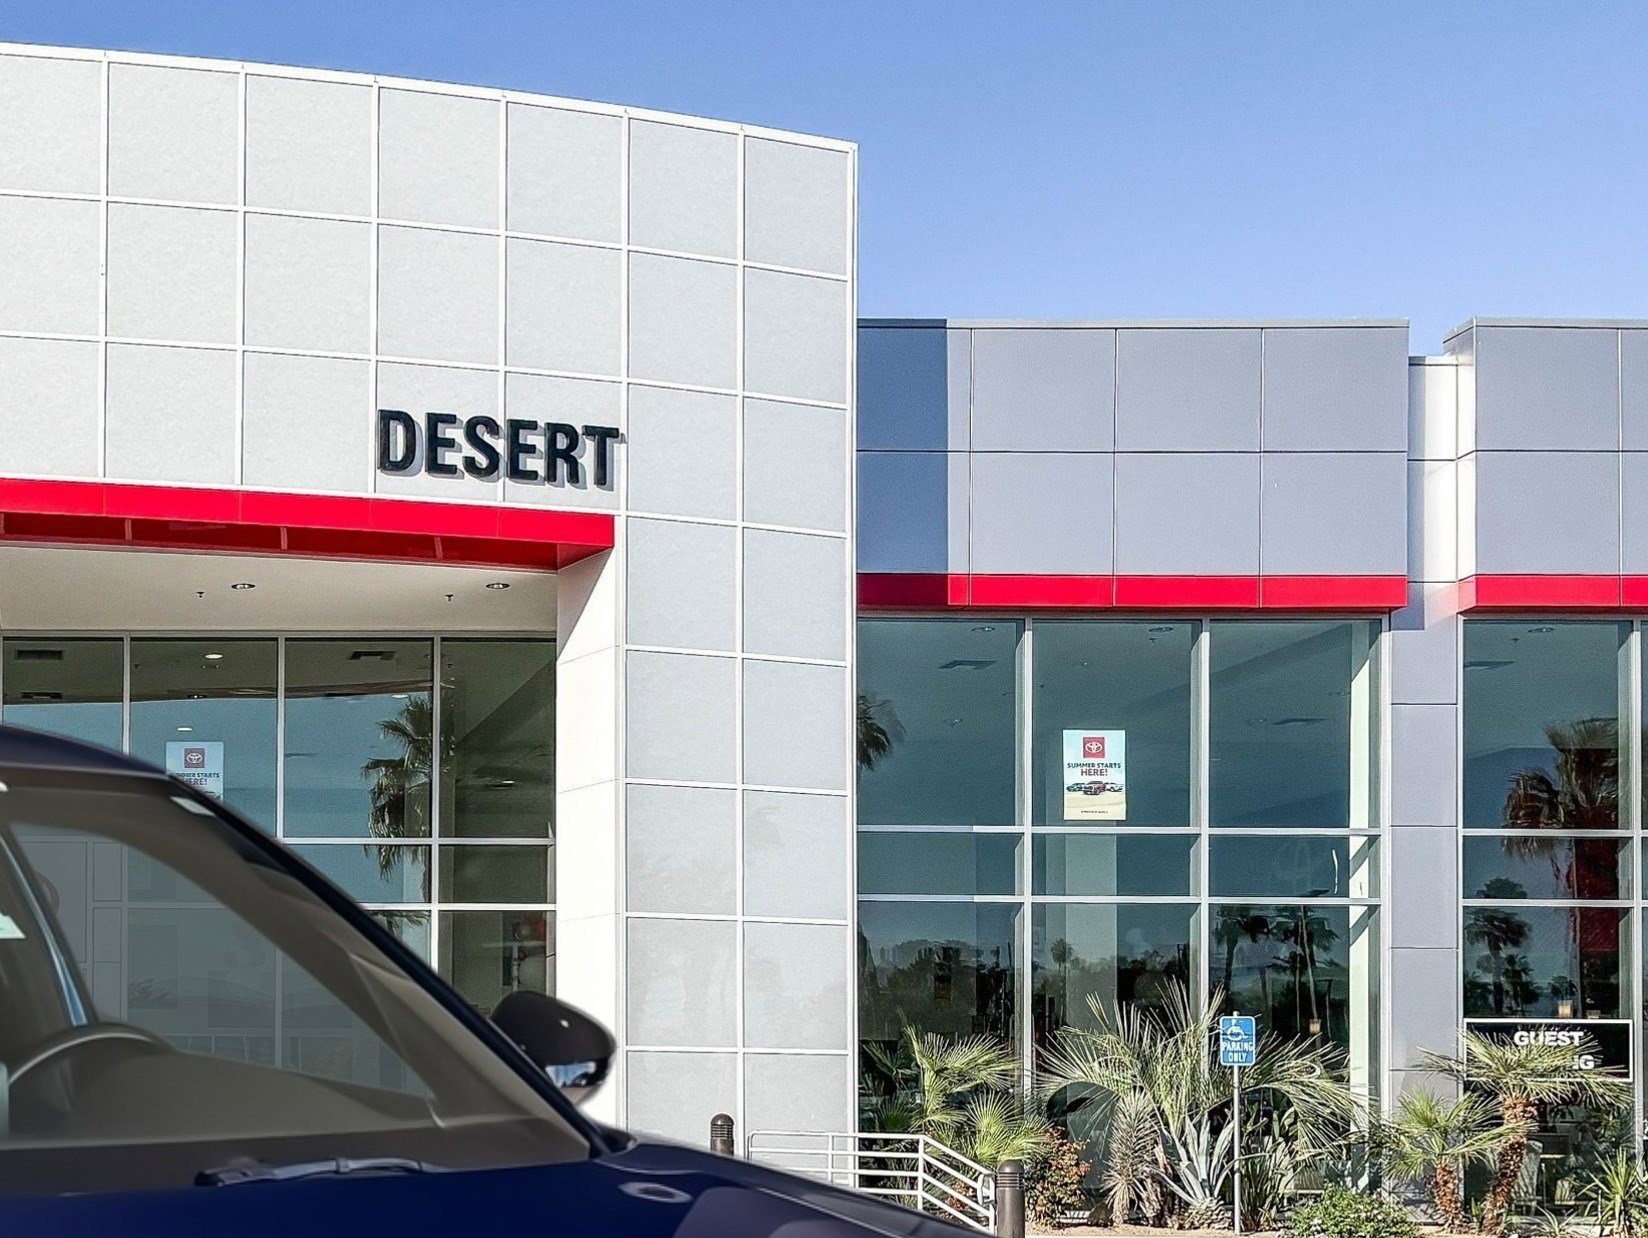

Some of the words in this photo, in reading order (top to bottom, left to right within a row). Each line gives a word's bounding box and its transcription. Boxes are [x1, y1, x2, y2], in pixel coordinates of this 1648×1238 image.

[377, 409, 619, 487] DESERT
[1080, 768, 1108, 776] HERE!
[1513, 1031, 1584, 1047] GUEST
[1222, 1041, 1253, 1051] PARKING
[1228, 1052, 1247, 1062] ONLY
